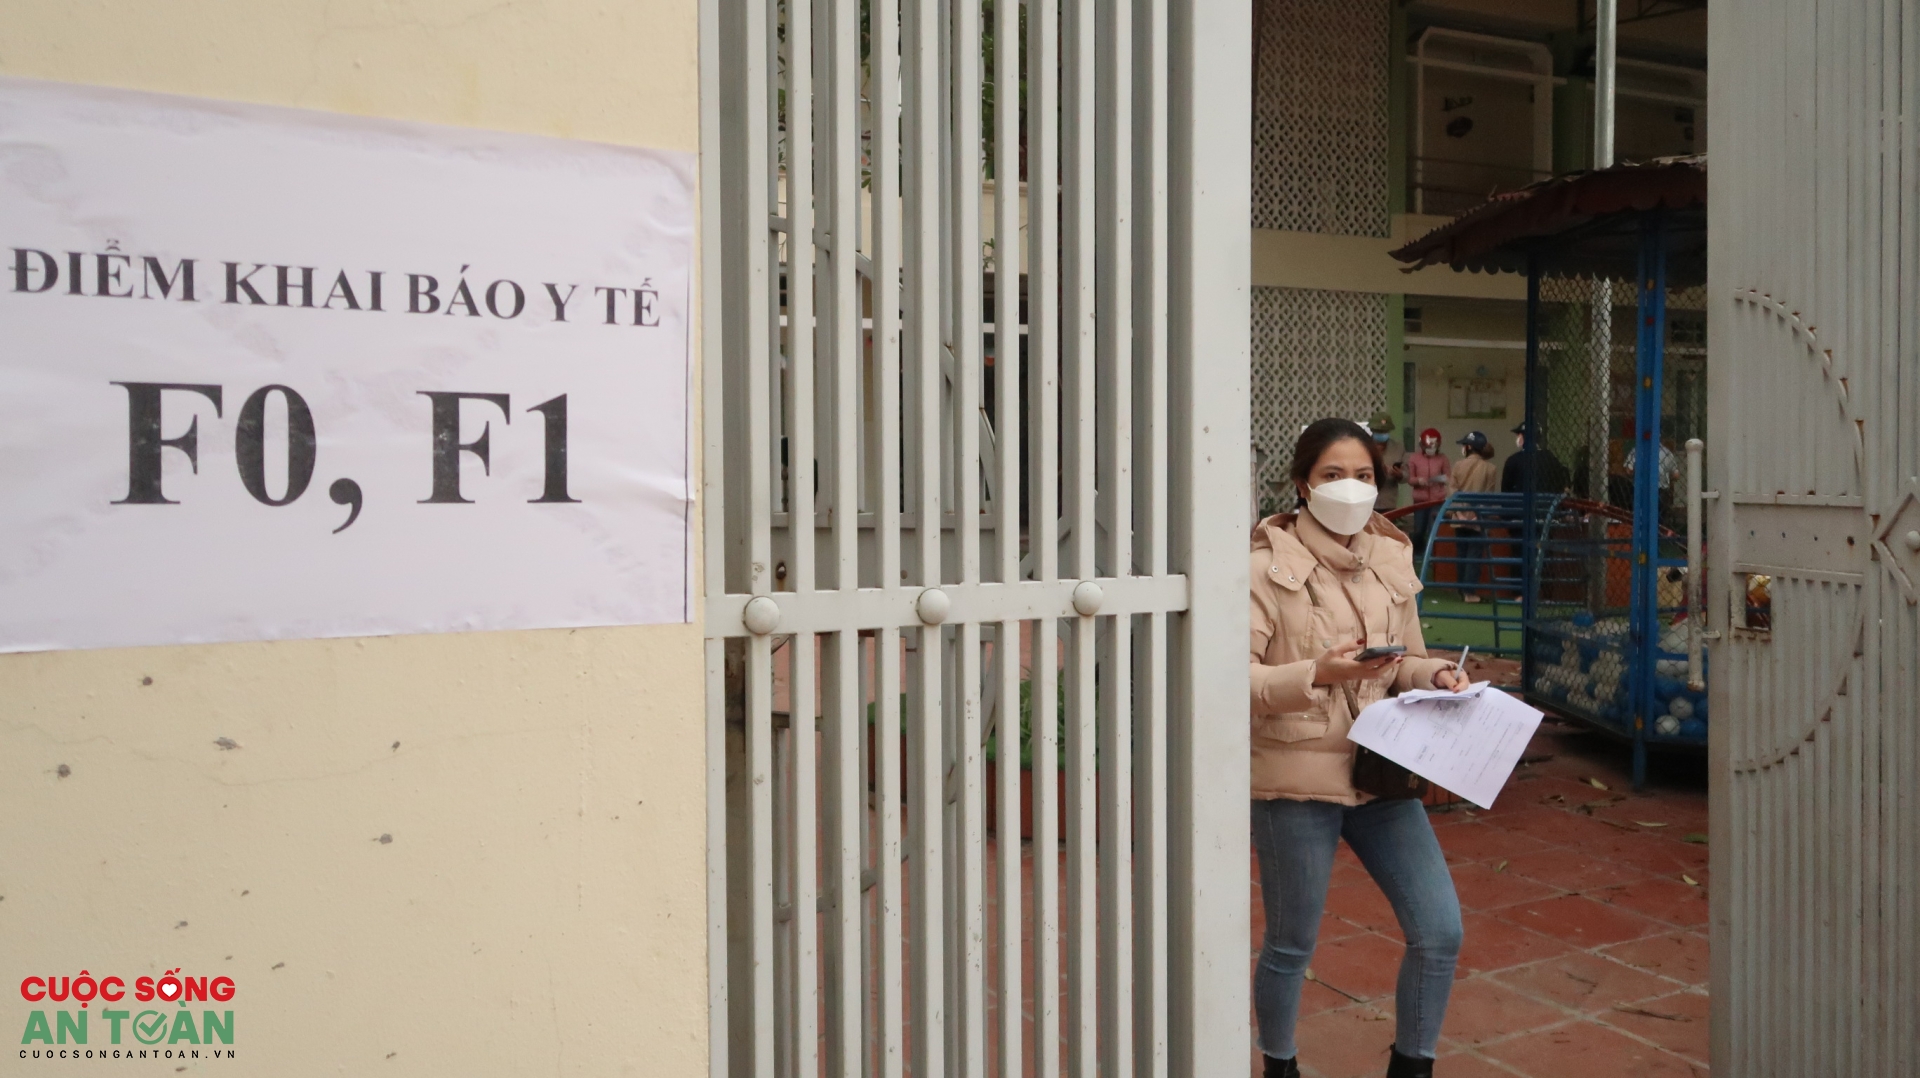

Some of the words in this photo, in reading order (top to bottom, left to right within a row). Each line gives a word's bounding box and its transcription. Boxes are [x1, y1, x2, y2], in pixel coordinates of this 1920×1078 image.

[8, 238, 200, 303] ĐIỂM
[221, 261, 388, 313] KHAI
[404, 263, 527, 320] BÁO
[540, 282, 580, 323] Y
[594, 276, 661, 328] TẾ
[109, 380, 363, 535] F0,
[415, 390, 583, 504] F1
